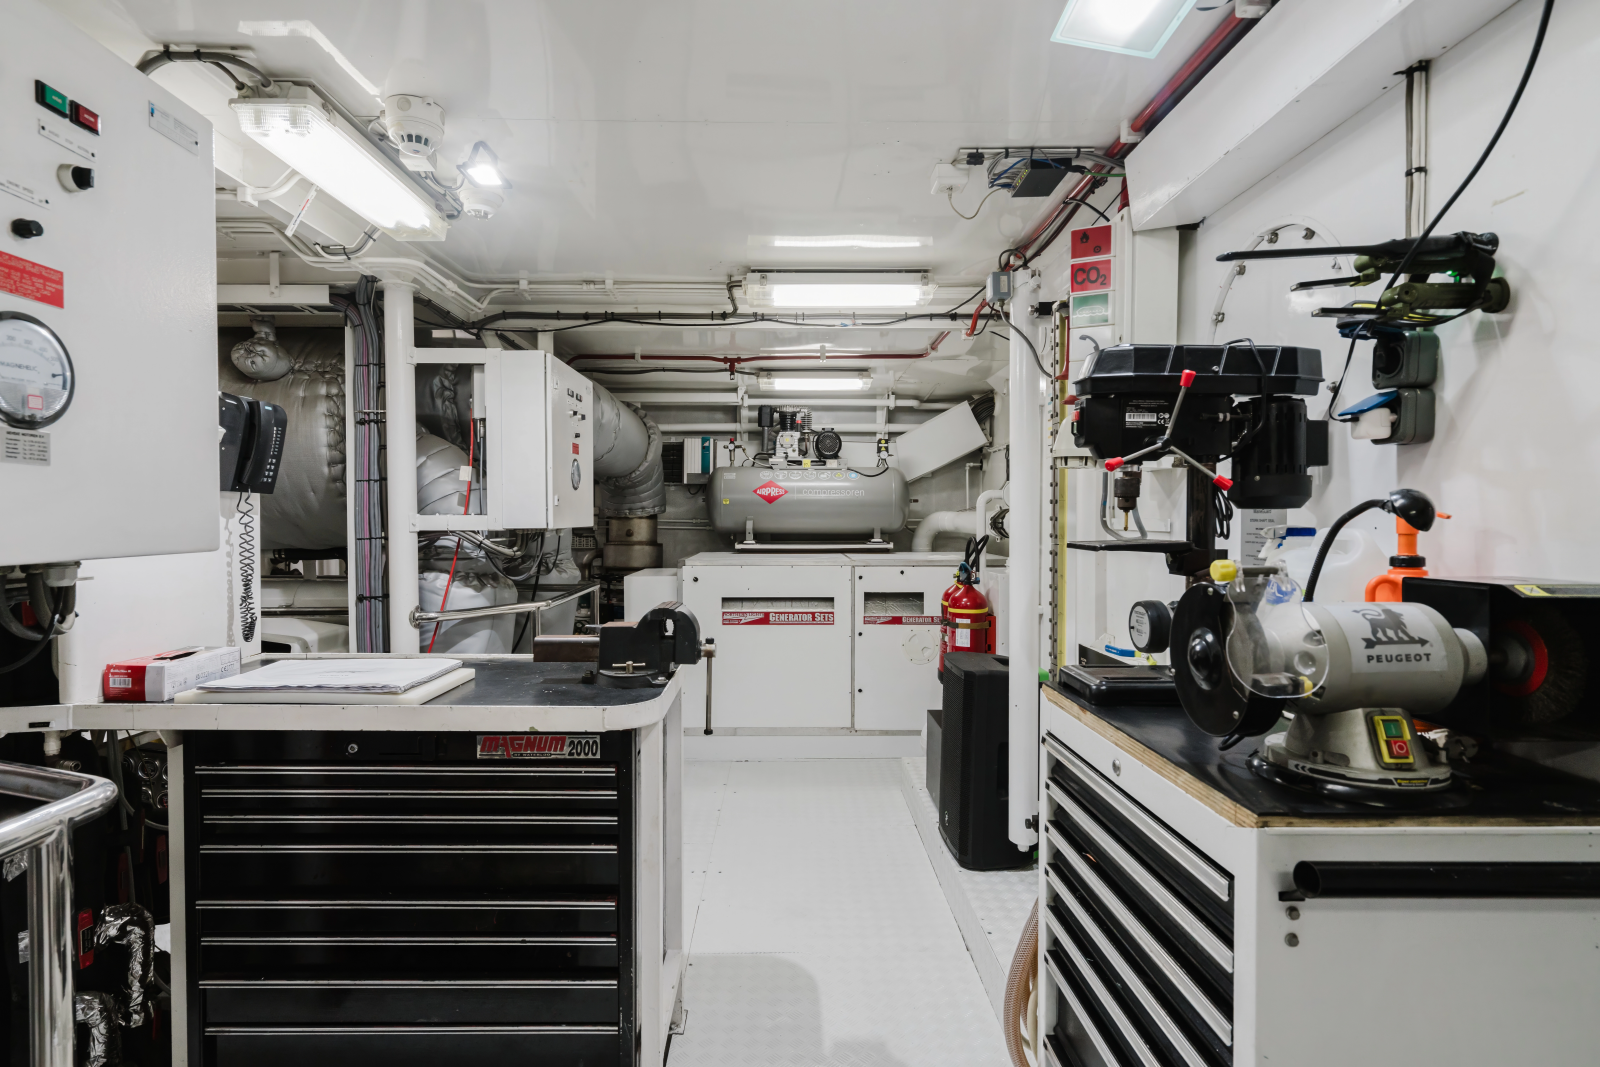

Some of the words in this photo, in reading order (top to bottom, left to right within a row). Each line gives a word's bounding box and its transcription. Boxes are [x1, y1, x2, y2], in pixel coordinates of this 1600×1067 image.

[757, 487, 785, 496] AIRPRESS
[802, 488, 865, 498] compressoren
[769, 612, 812, 622] GENERATOR
[815, 612, 834, 622] SETS
[1366, 653, 1431, 664] PEUGEOT
[480, 735, 567, 758] MAGNUM
[568, 739, 598, 757] 2000
